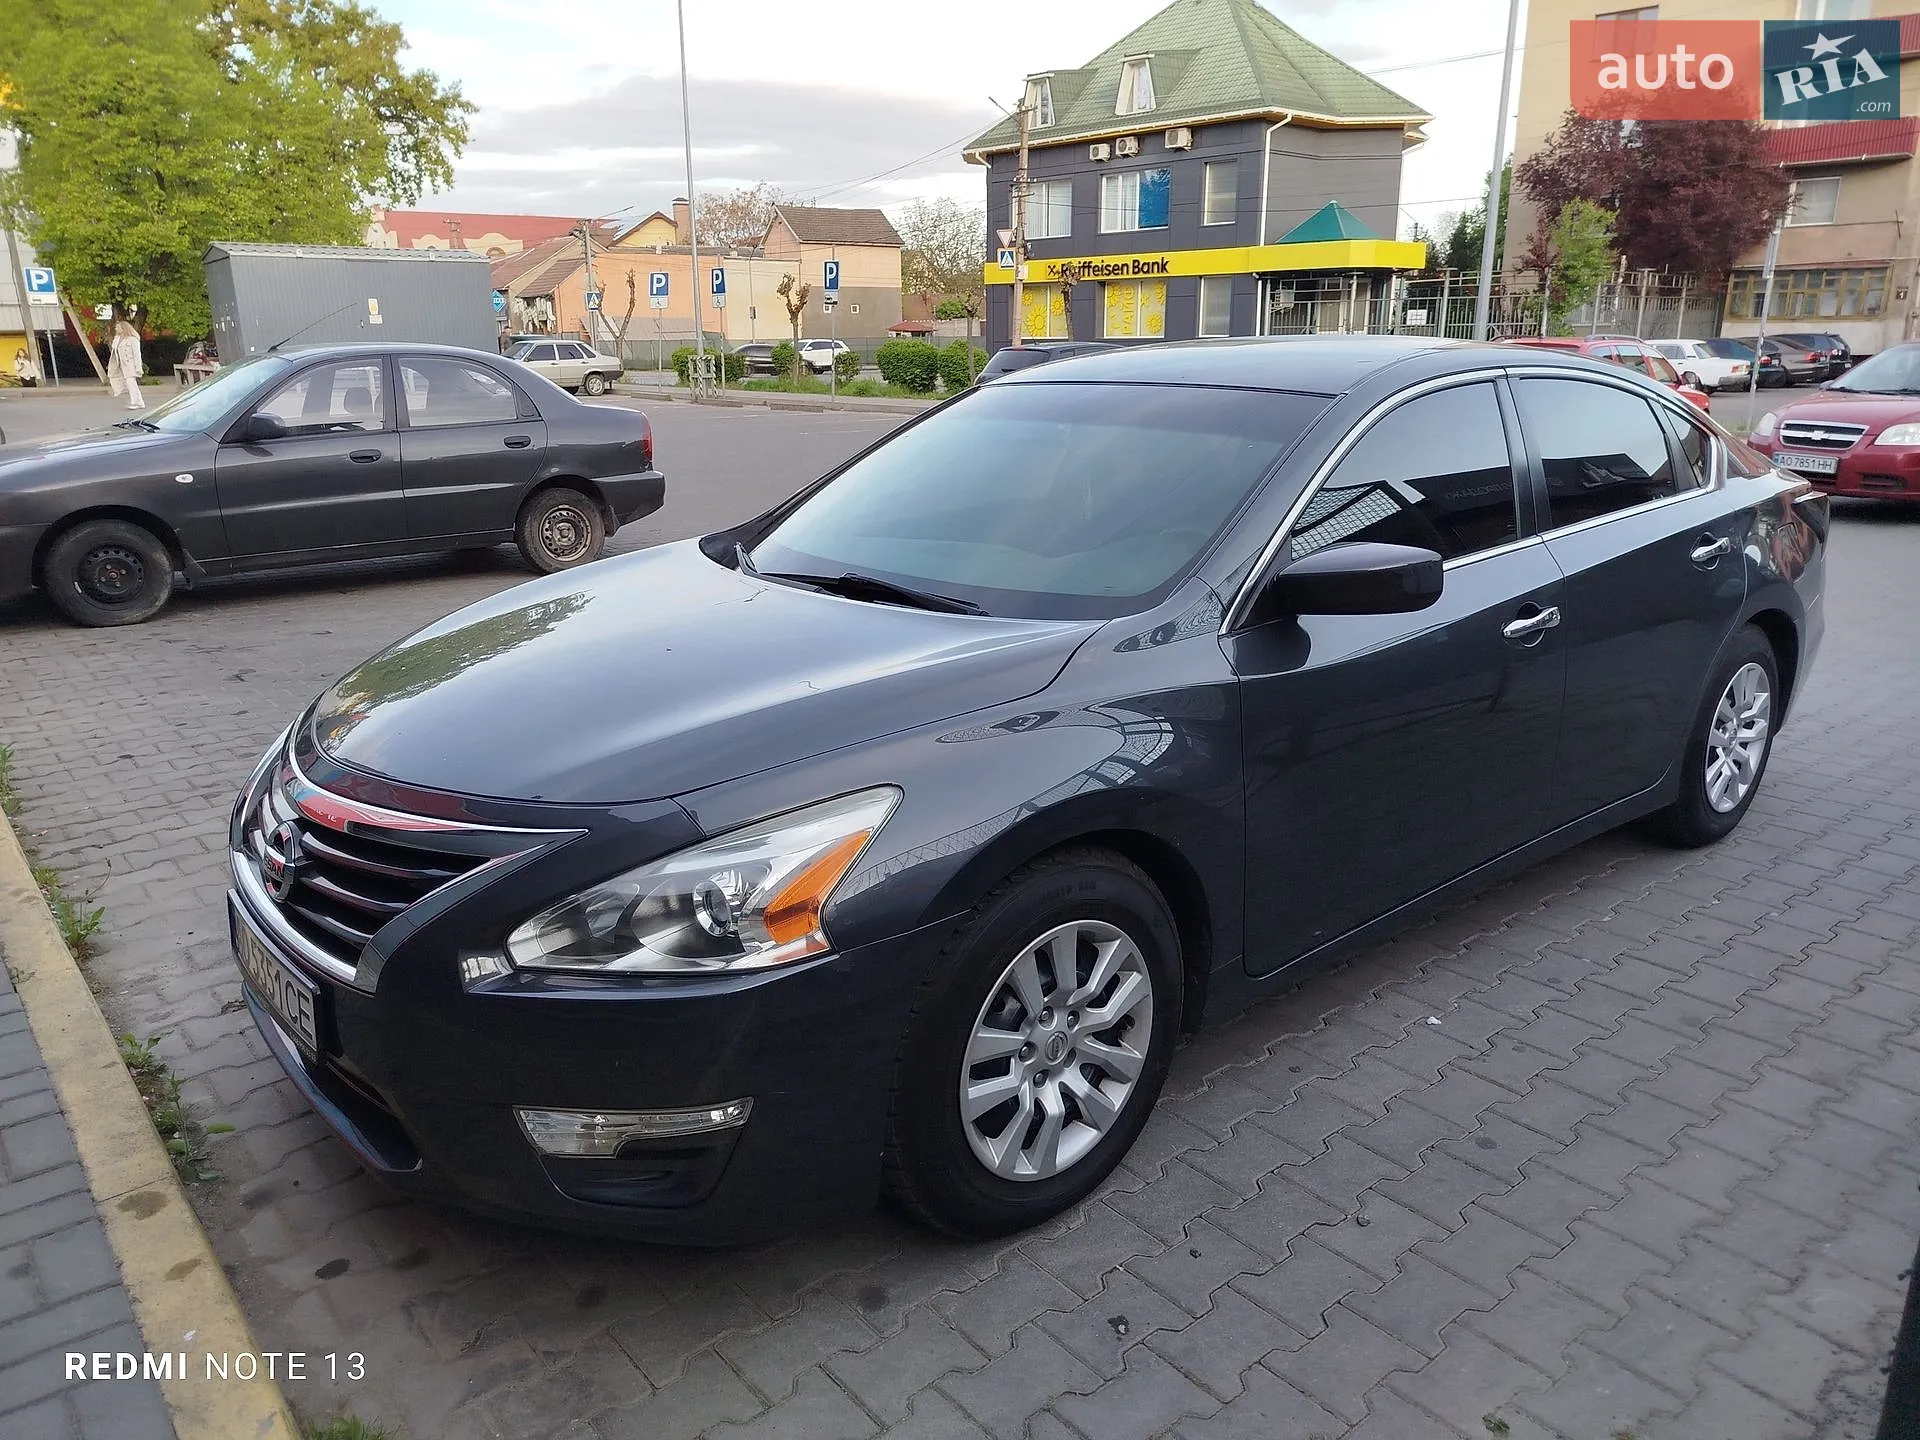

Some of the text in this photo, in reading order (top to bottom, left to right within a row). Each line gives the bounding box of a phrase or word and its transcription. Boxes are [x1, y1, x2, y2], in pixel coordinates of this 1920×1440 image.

[826, 263, 837, 289] P
[1060, 257, 1169, 277] Riffeisen Bank
[30, 270, 48, 290] P
[653, 273, 666, 294] P
[713, 269, 722, 293] P
